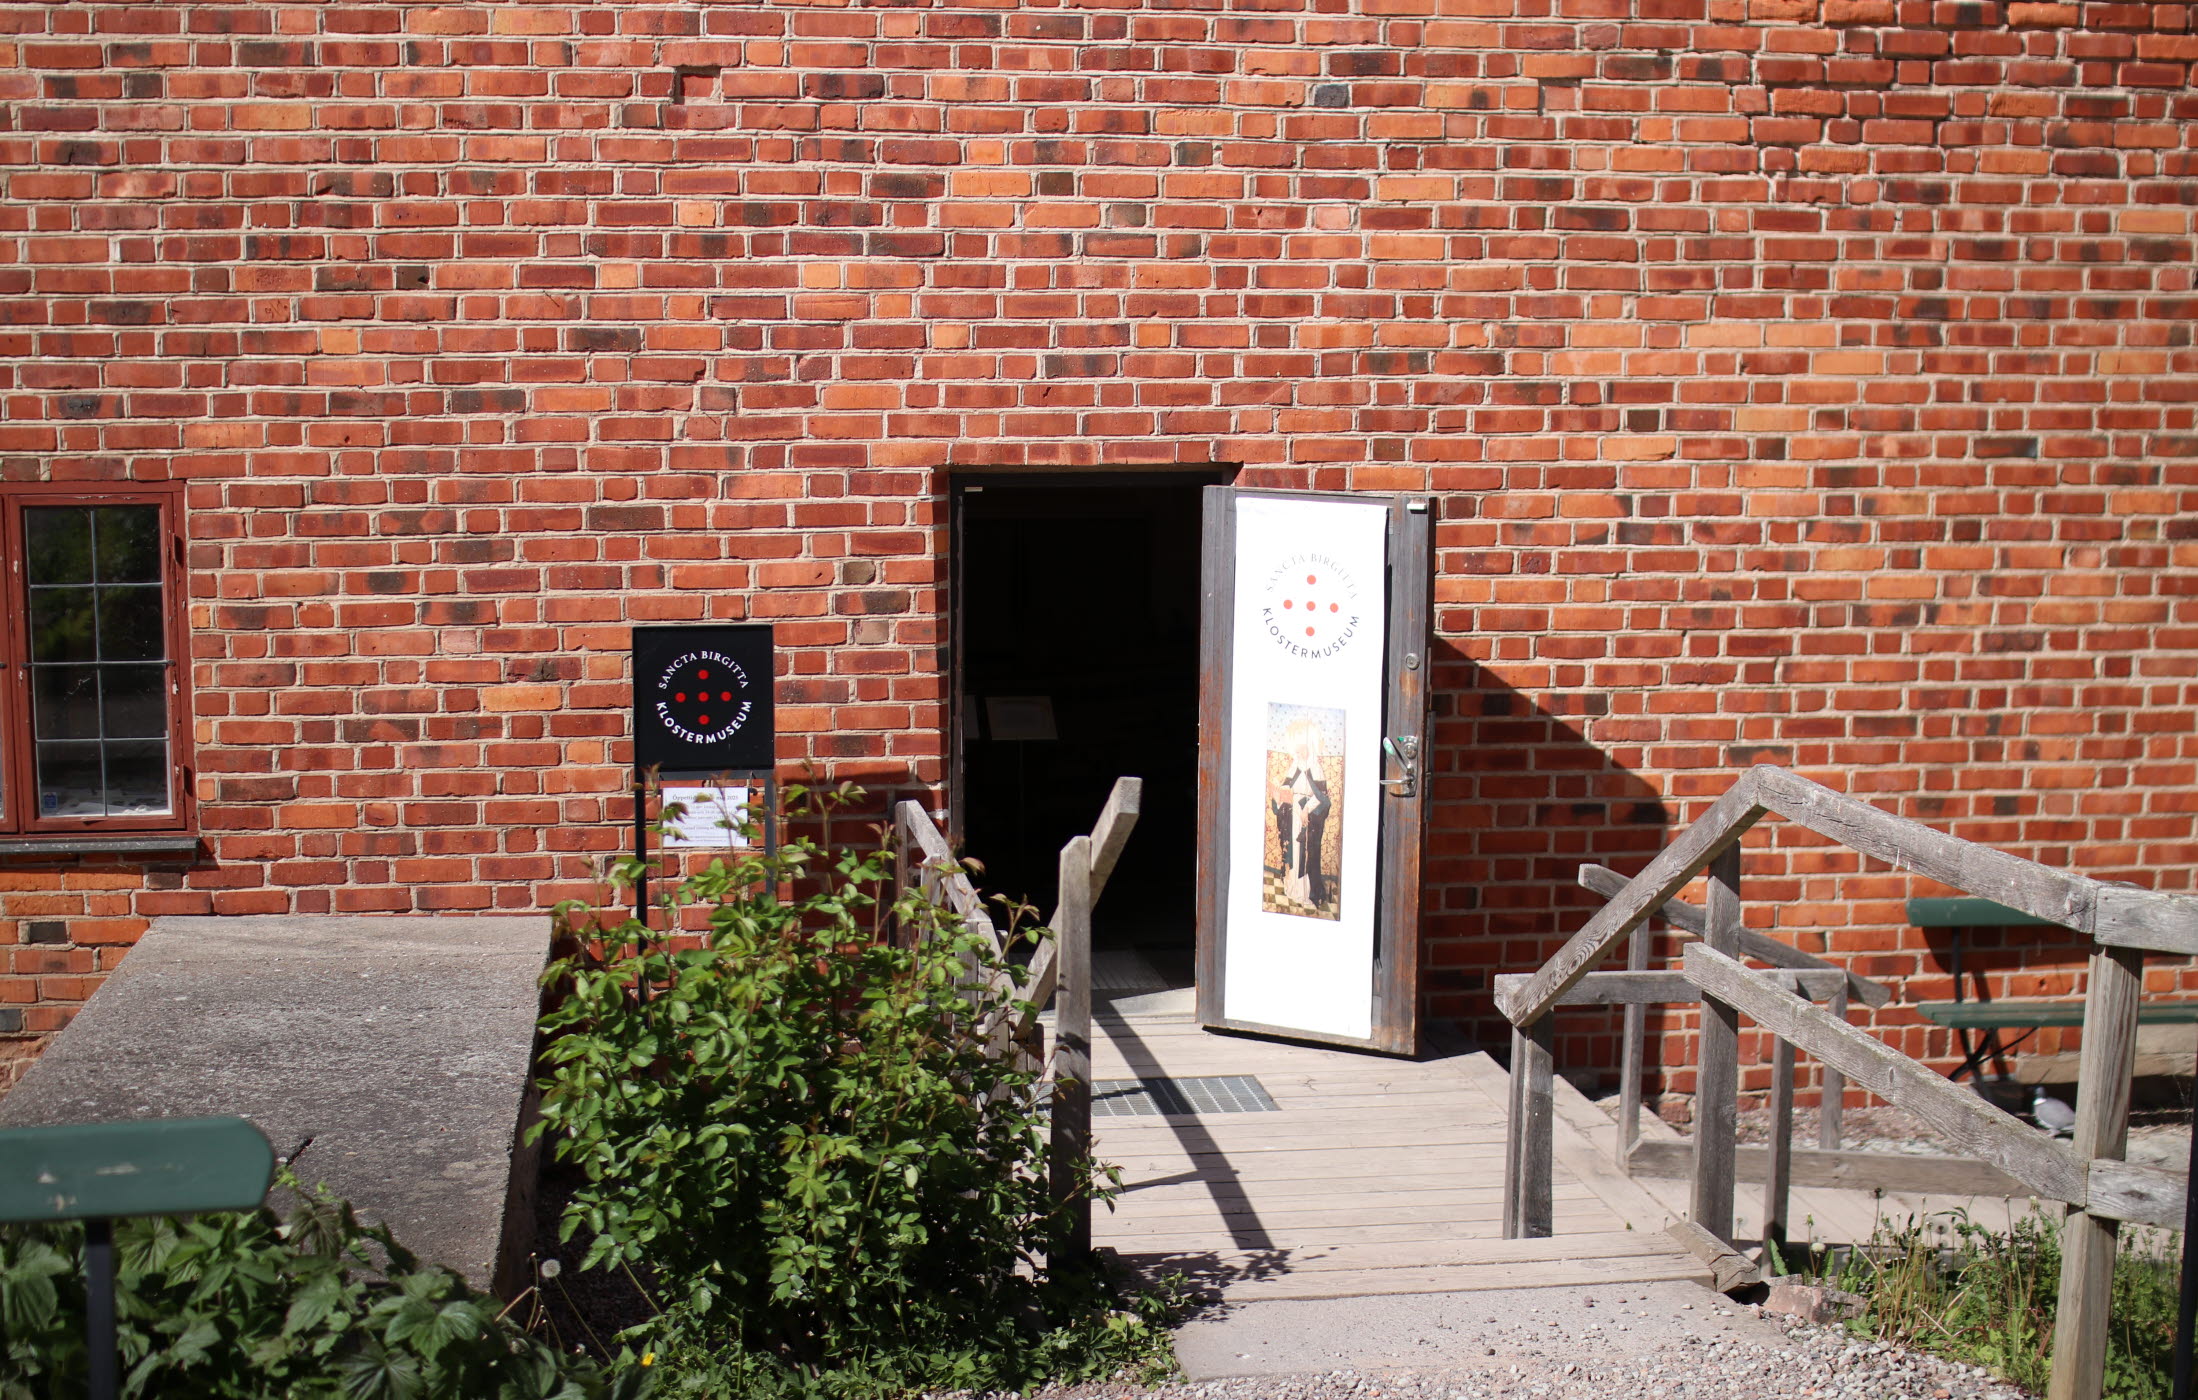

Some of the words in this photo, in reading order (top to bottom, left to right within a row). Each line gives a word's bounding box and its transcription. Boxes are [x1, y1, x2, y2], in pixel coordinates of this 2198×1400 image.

[1266, 555, 1305, 592] SANCTA
[1311, 553, 1358, 599] BIRGITTA
[1262, 607, 1360, 659] KLOSTERMUSEUM
[658, 652, 698, 690] SANCTA
[701, 650, 749, 689] BIRGITTA
[656, 701, 752, 744] KLOSTERMUSEUM
